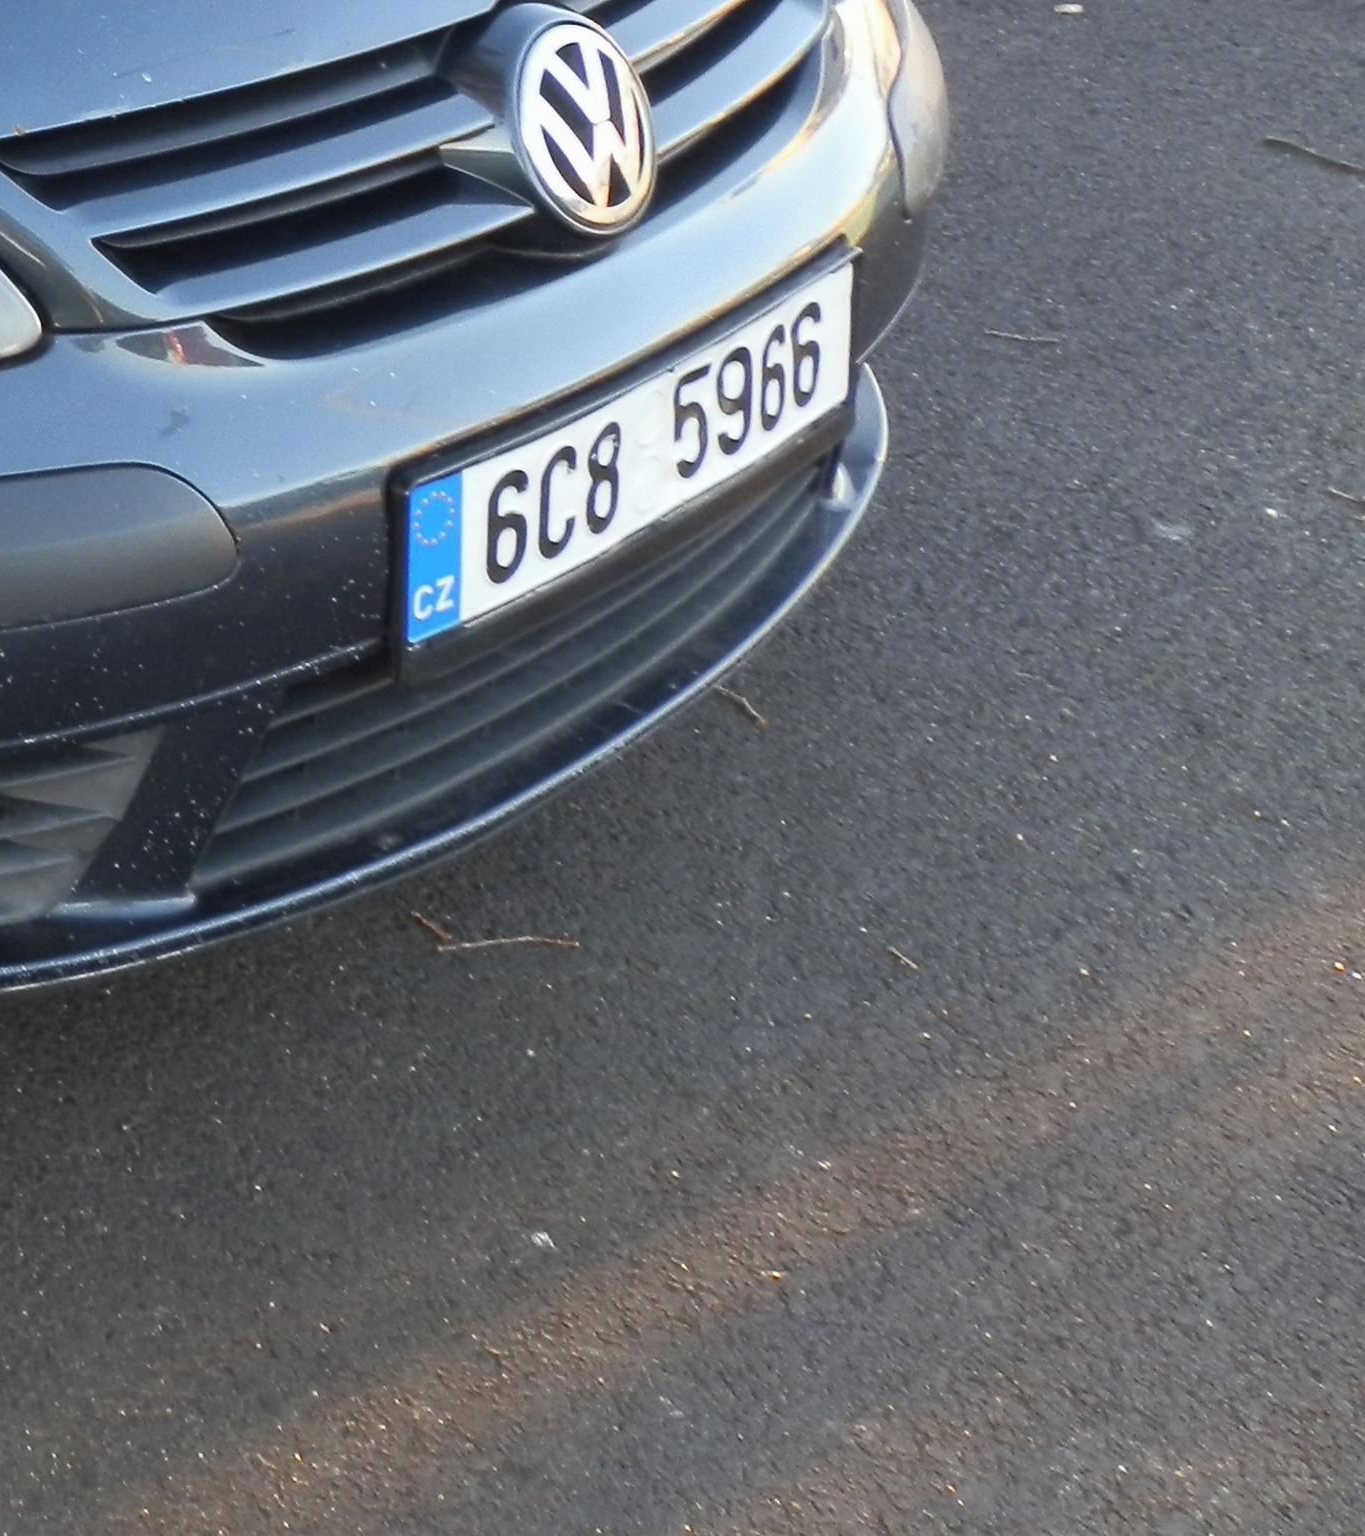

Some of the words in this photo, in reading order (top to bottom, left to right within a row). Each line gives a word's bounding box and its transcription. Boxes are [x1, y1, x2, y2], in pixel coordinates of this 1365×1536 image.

[519, 22, 651, 220] VW
[485, 421, 624, 586] 6C8
[671, 300, 824, 480] 5966
[412, 575, 455, 621] CZ
